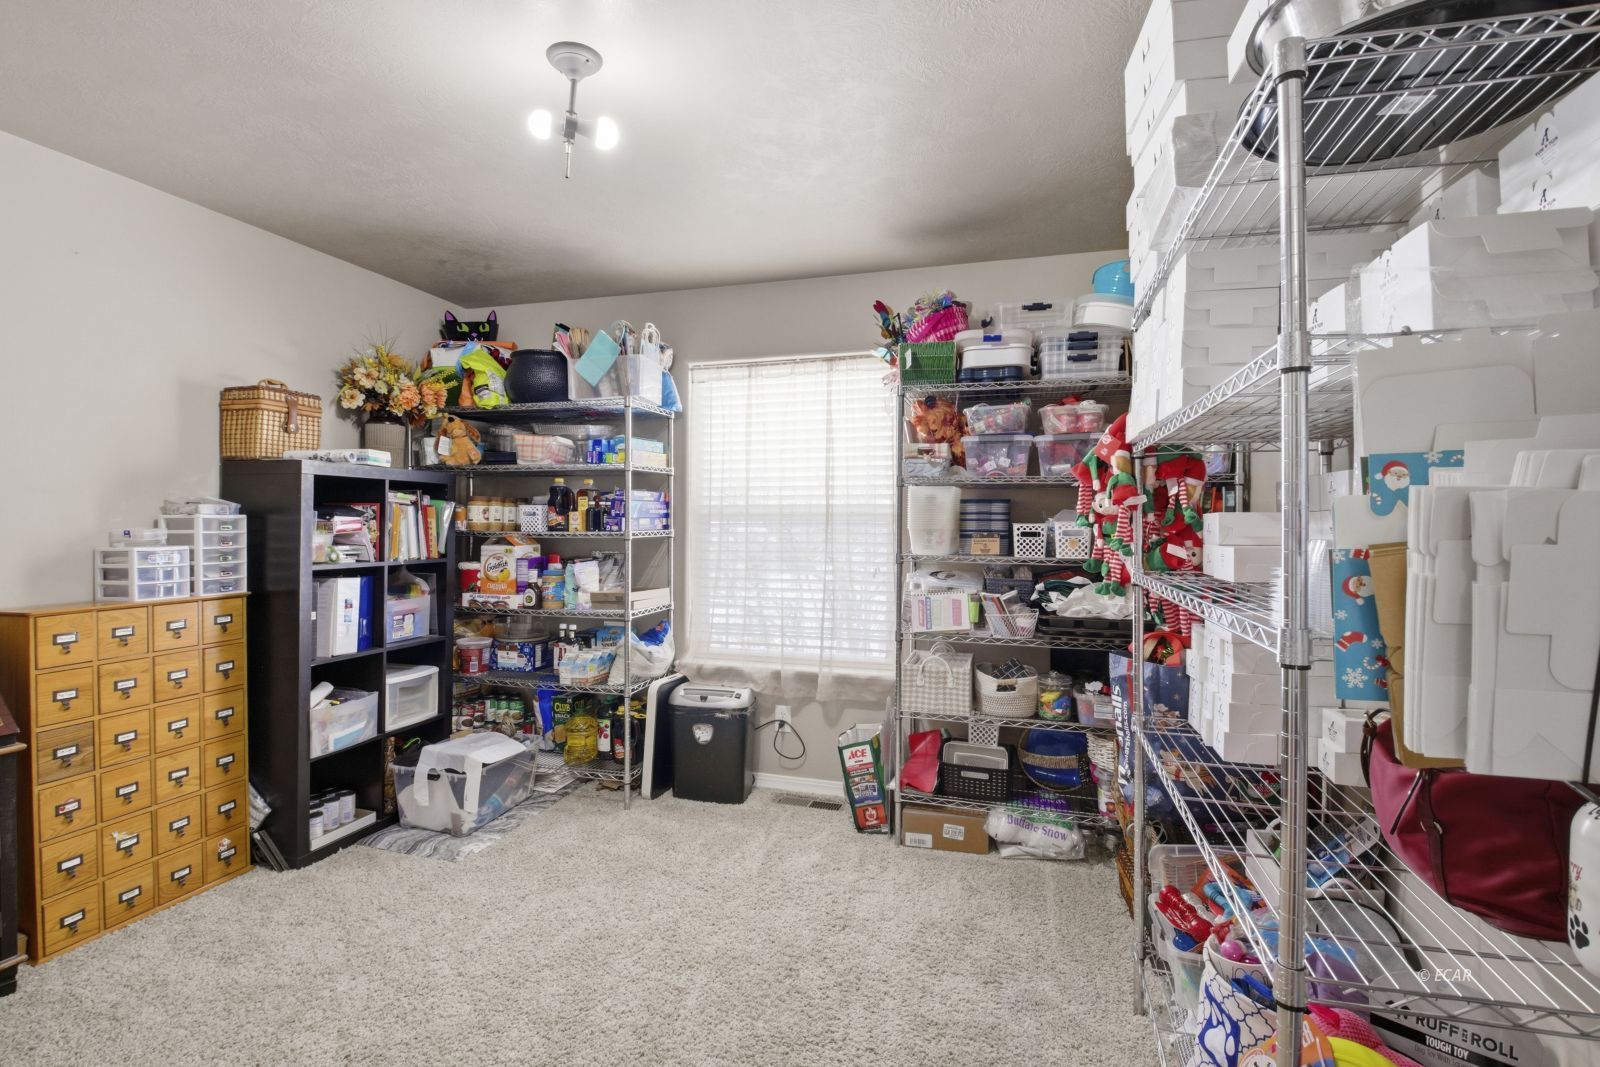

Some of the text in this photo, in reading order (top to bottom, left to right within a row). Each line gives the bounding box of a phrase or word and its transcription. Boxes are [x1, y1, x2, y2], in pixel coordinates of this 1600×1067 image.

[848, 748, 868, 760] ACE
[1007, 814, 1069, 841] Buffalo Snow
[1415, 1016, 1461, 1037] RUFF
[1470, 1032, 1519, 1061] ROLL
[1425, 1035, 1469, 1060] TOUGH TOY
